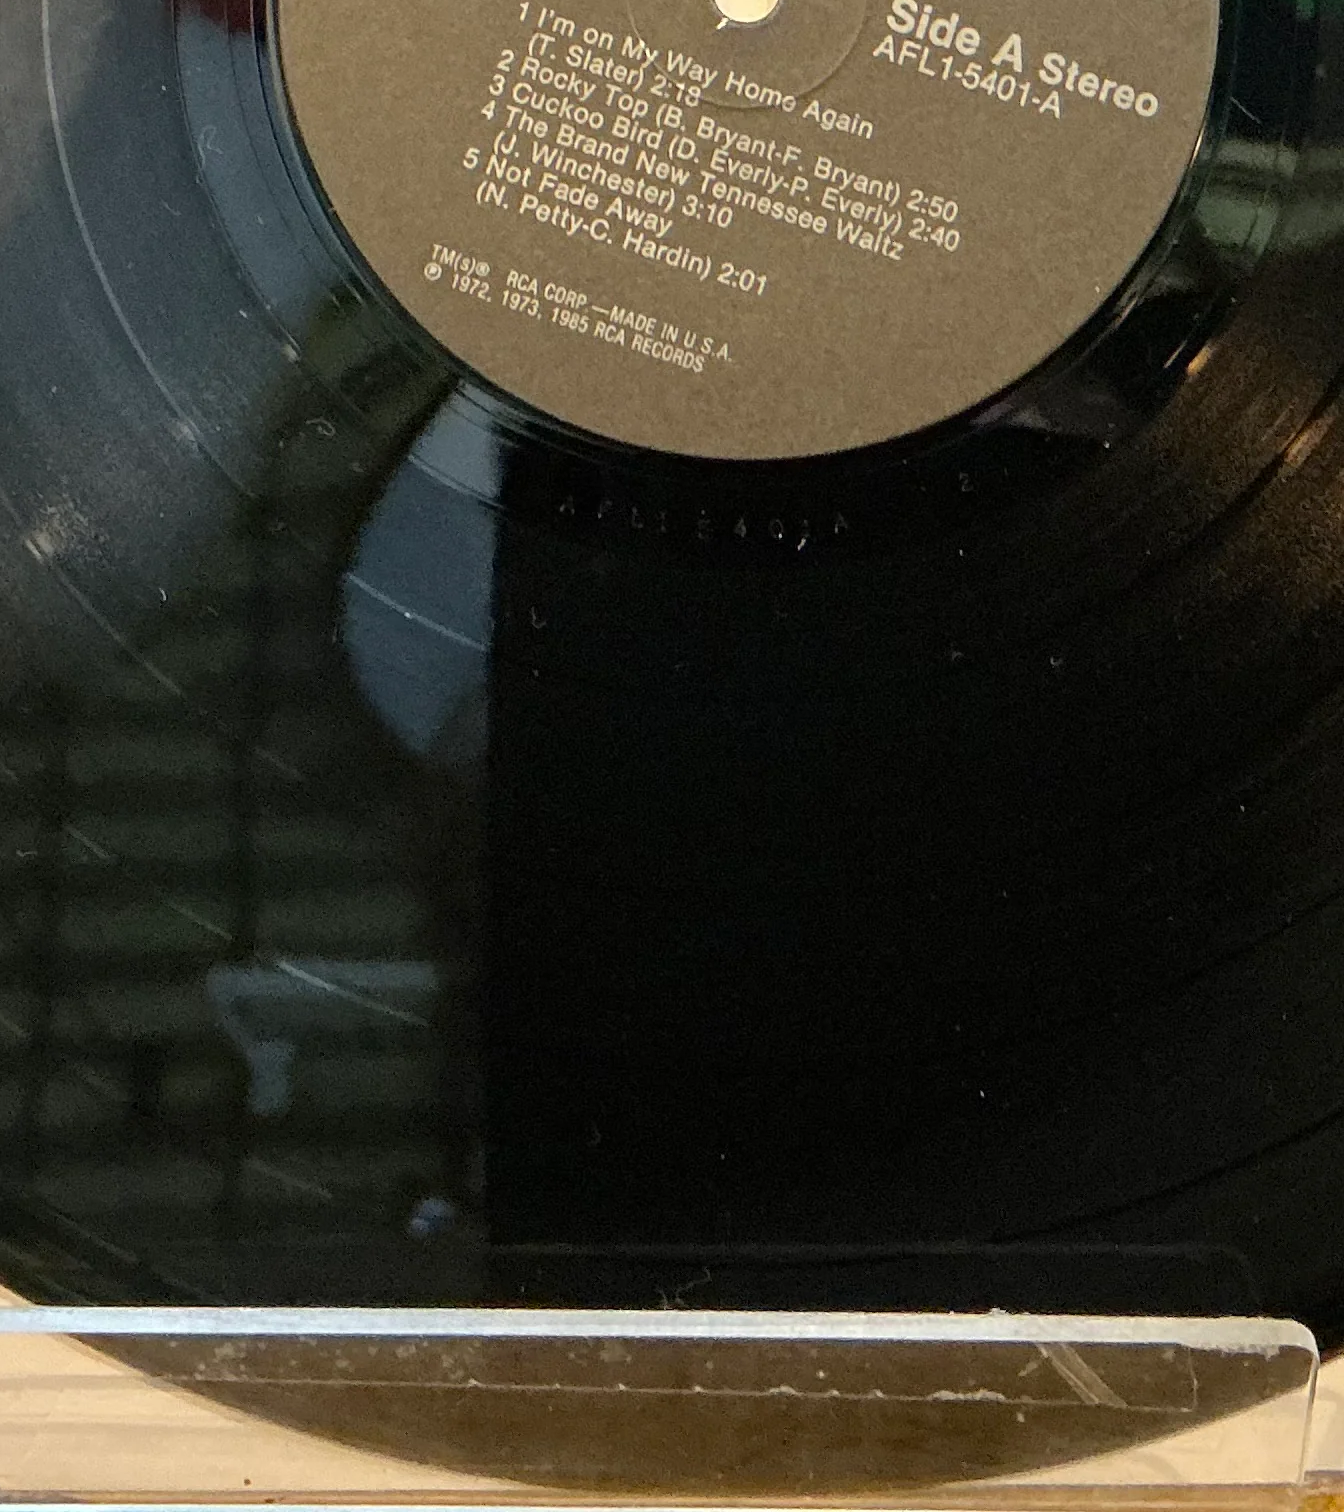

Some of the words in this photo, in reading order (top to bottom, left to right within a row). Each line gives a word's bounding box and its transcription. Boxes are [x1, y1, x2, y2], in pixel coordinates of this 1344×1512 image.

[520, 2, 529, 21] 1
[583, 27, 614, 50] on
[621, 35, 659, 70] My
[660, 51, 718, 89] Way
[724, 71, 796, 113] Home
[802, 99, 873, 139] Again
[528, 32, 556, 60] (T.
[565, 45, 647, 92] Slater)
[650, 74, 701, 108] 2:18
[873, 35, 1061, 119] AFL1-5401-A
[991, 33, 1023, 73] A
[1039, 52, 1159, 117] Stereo
[480, 100, 496, 121] 4
[506, 104, 548, 138] The
[556, 124, 630, 166] Brand
[635, 151, 690, 186] New
[693, 170, 828, 234] Tennessee
[836, 218, 904, 261] Waltz
[488, 74, 506, 96] 3
[511, 82, 604, 130] Cuckoo
[611, 115, 663, 150] Bird
[668, 134, 699, 164] (D.
[704, 150, 810, 202] Everly-P.
[821, 187, 902, 236] Everly)
[908, 217, 960, 252] 2:40
[493, 131, 520, 158] (J.
[525, 142, 676, 213] Winchester)
[681, 194, 733, 228] 3:10
[497, 49, 515, 72] 2
[519, 56, 597, 101] Rocky
[606, 83, 649, 119] Top
[655, 103, 685, 132] (B.
[696, 116, 803, 171] Bryant-F.
[813, 155, 901, 207] Bryant)
[906, 189, 959, 223] 2:50
[462, 147, 480, 170] 5
[485, 154, 531, 188] Not
[538, 172, 599, 211] Fade
[601, 197, 673, 238] Away
[476, 180, 508, 209] (N.
[519, 194, 612, 244] Petty-C.
[622, 228, 712, 282] Hardin)
[717, 262, 767, 296] 2:01
[506, 270, 538, 296] RCA
[660, 323, 679, 343] IN
[551, 307, 589, 333] 1985
[593, 321, 625, 346] RCA
[631, 334, 705, 373] RECORDS
